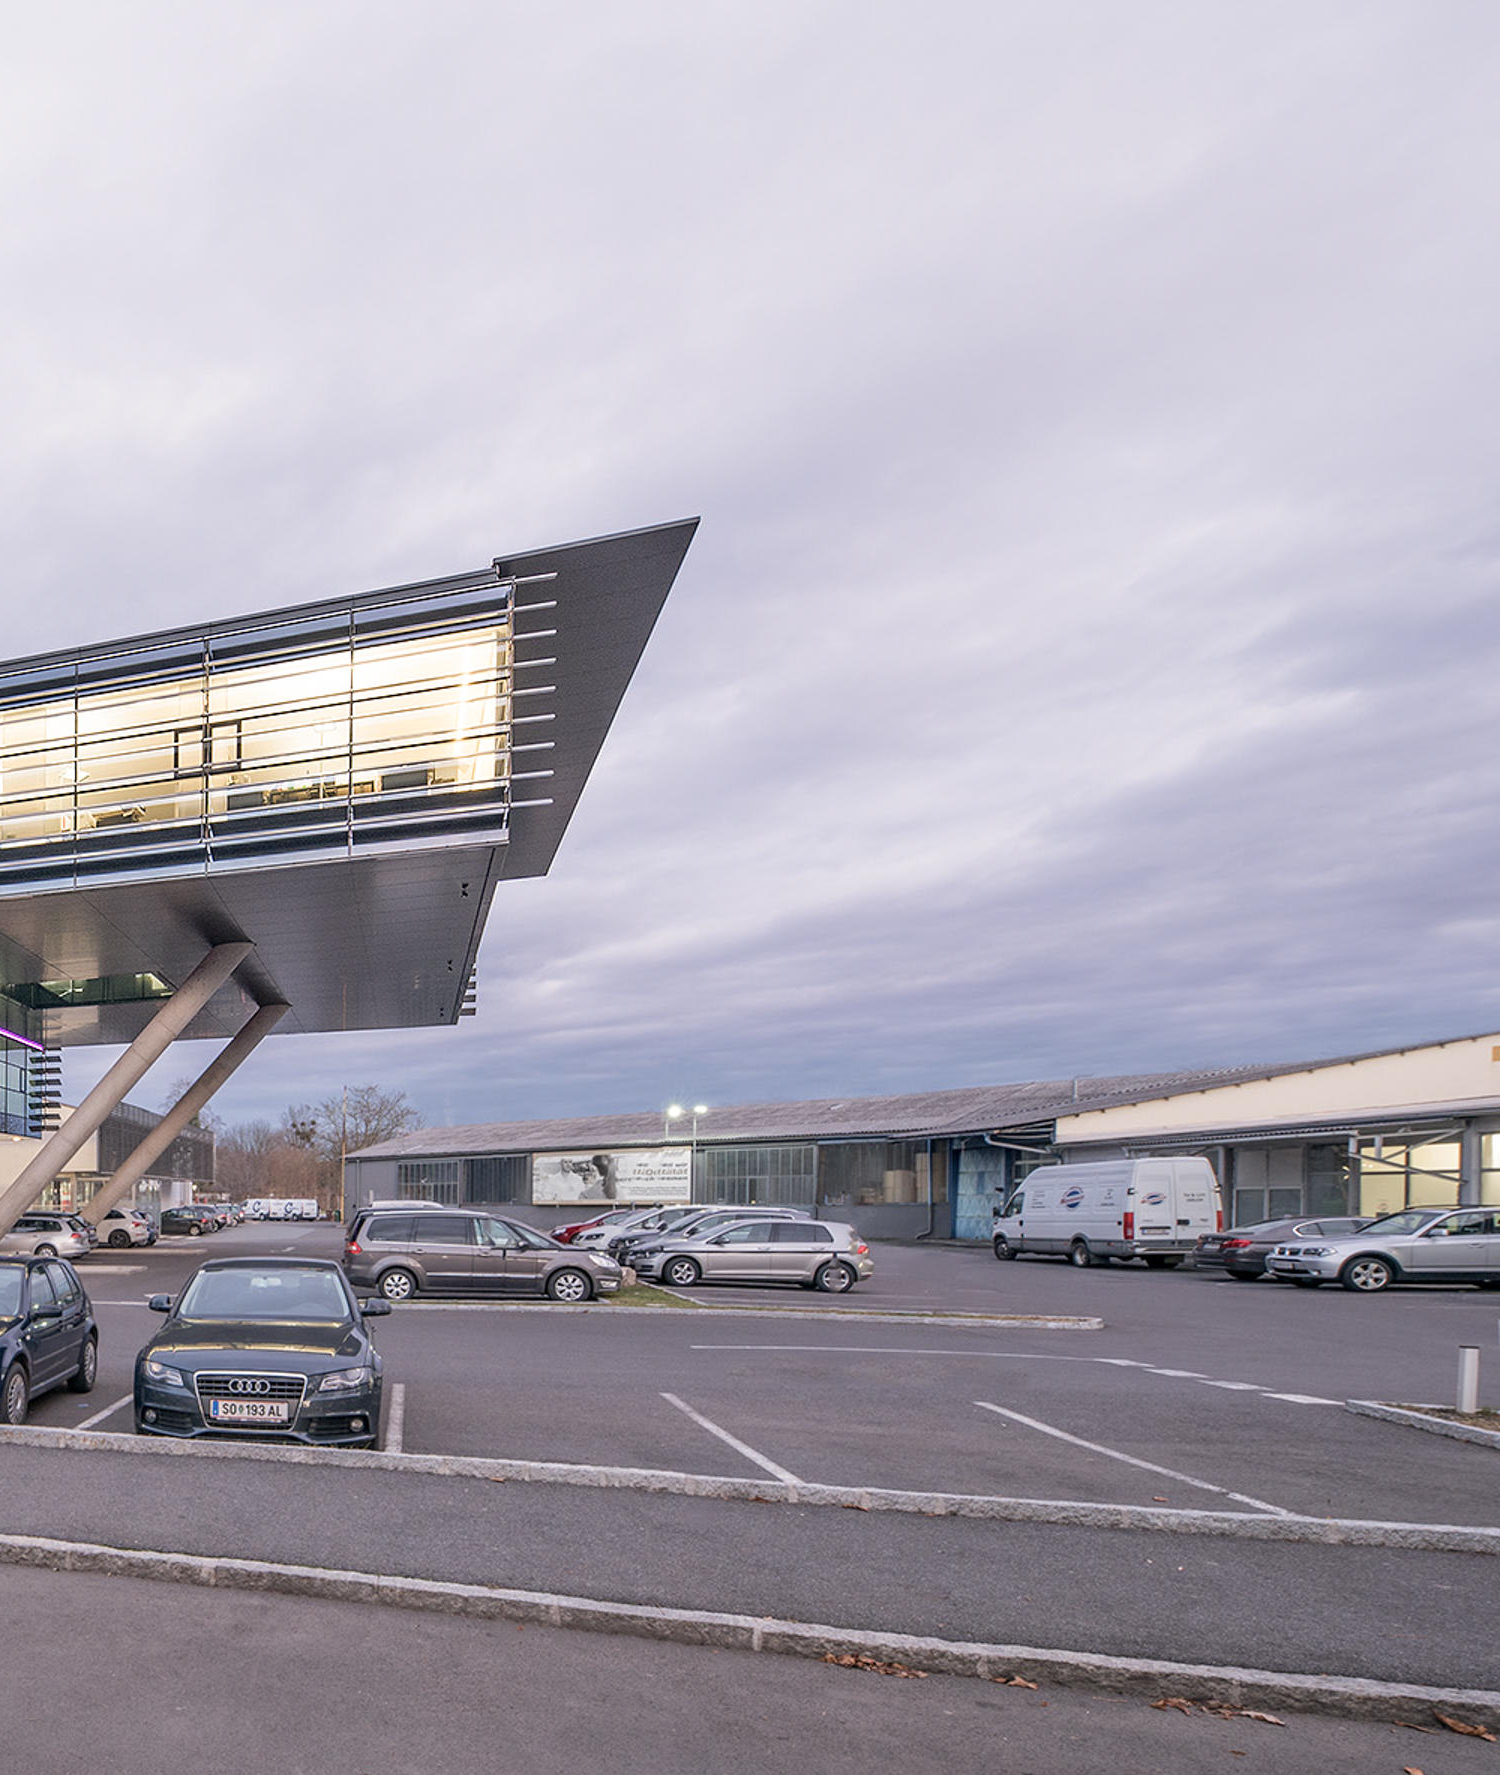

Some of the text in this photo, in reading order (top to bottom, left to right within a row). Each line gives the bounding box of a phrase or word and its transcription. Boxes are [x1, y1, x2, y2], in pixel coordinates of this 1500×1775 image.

[222, 1402, 282, 1417] SO 193 AL
